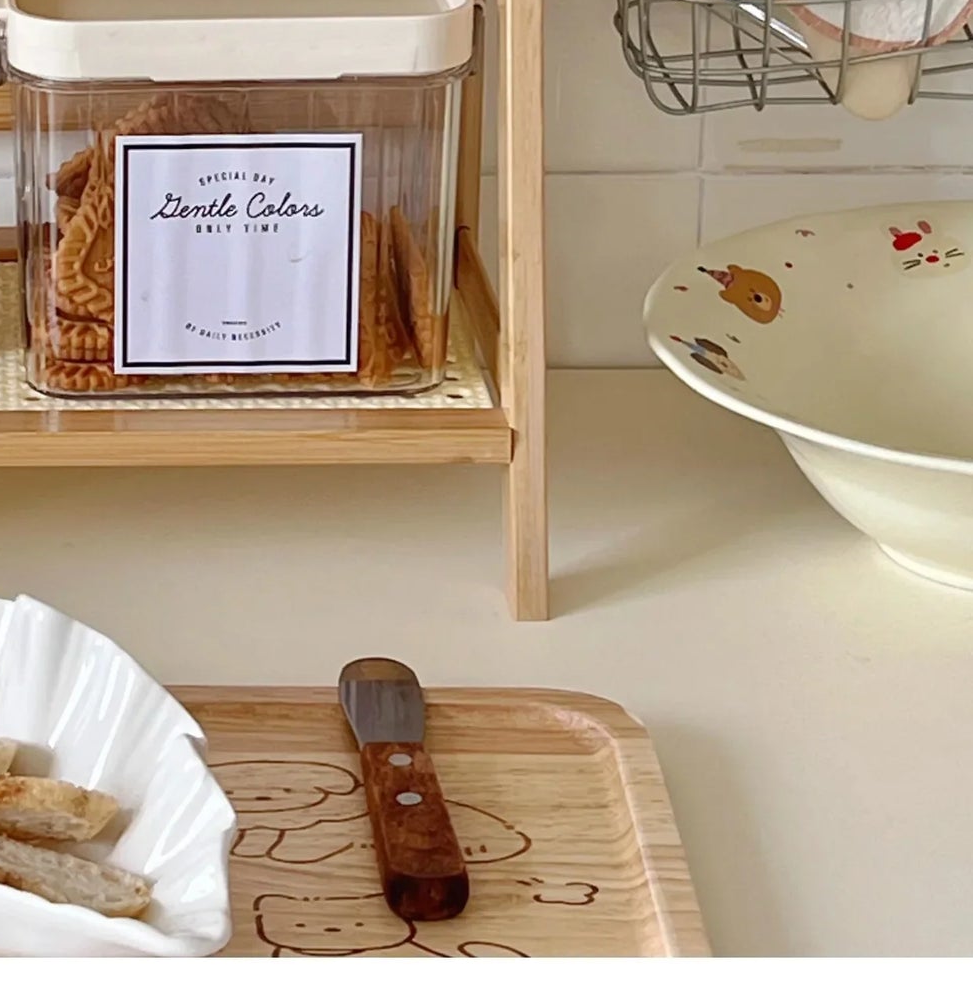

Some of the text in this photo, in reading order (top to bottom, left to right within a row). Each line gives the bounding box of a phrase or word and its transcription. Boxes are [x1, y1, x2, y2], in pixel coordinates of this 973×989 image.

[199, 171, 275, 187] SPECIAL DAY
[150, 191, 324, 220] Gentle Colors
[196, 223, 279, 234] ONLY TIME
